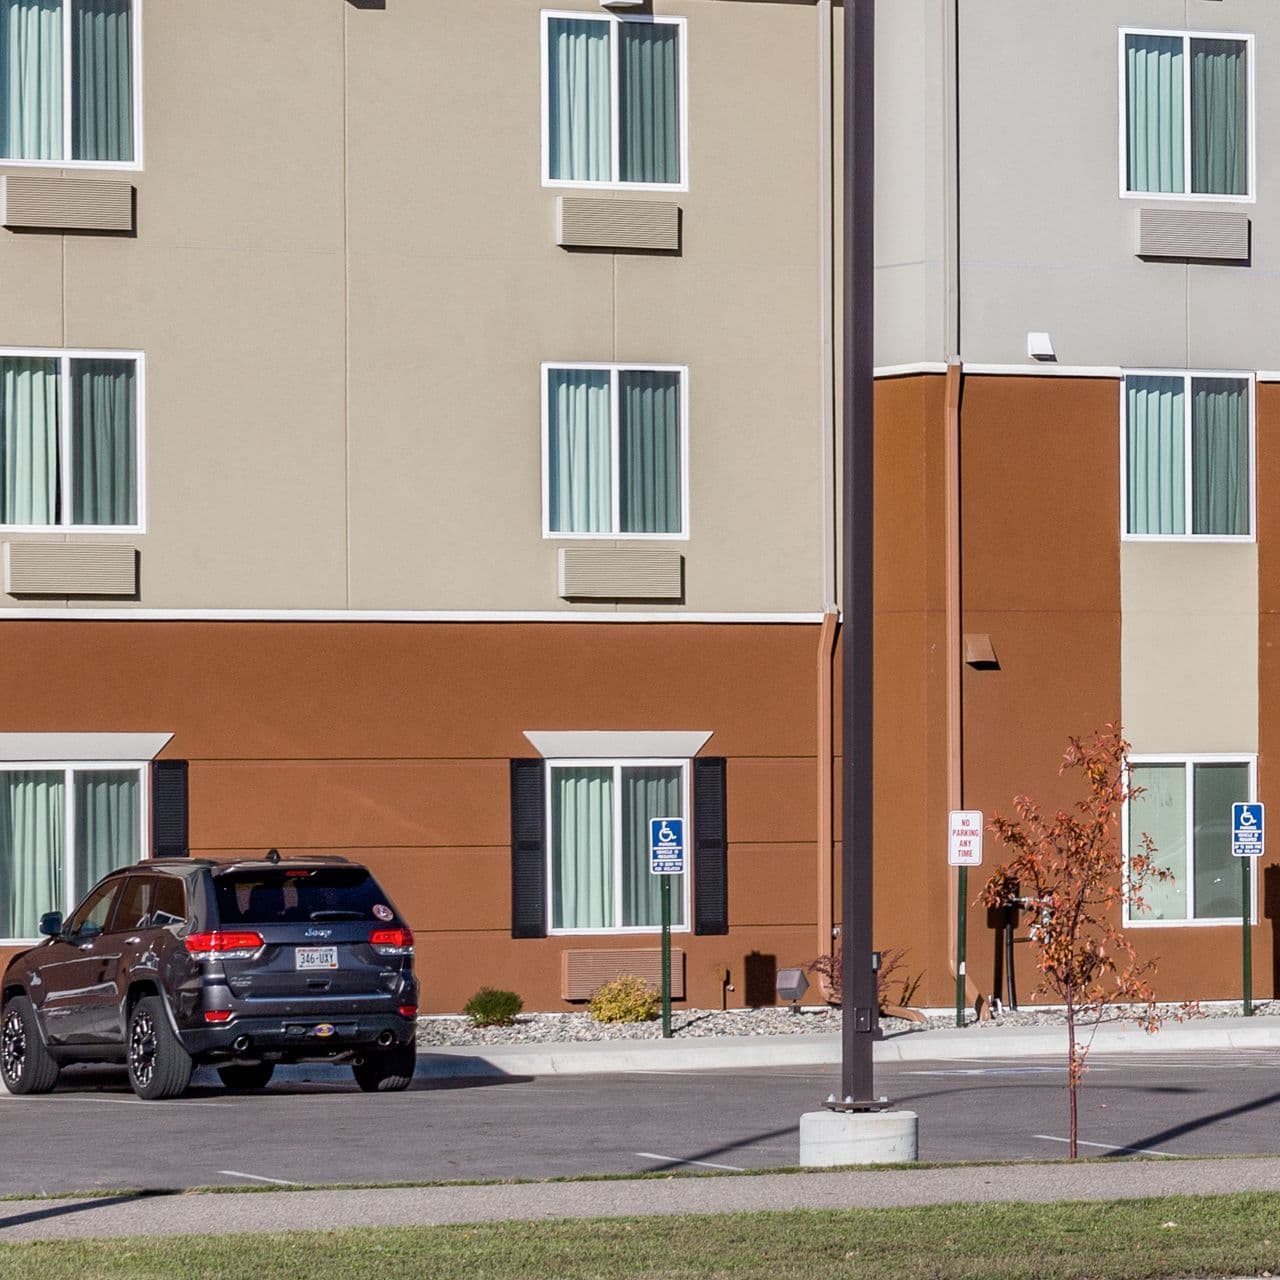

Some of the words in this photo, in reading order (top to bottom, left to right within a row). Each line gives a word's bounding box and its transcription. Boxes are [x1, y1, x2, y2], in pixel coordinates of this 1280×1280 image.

[961, 819, 971, 827] NO
[952, 829, 979, 837] PARKING
[957, 849, 974, 858] TIME
